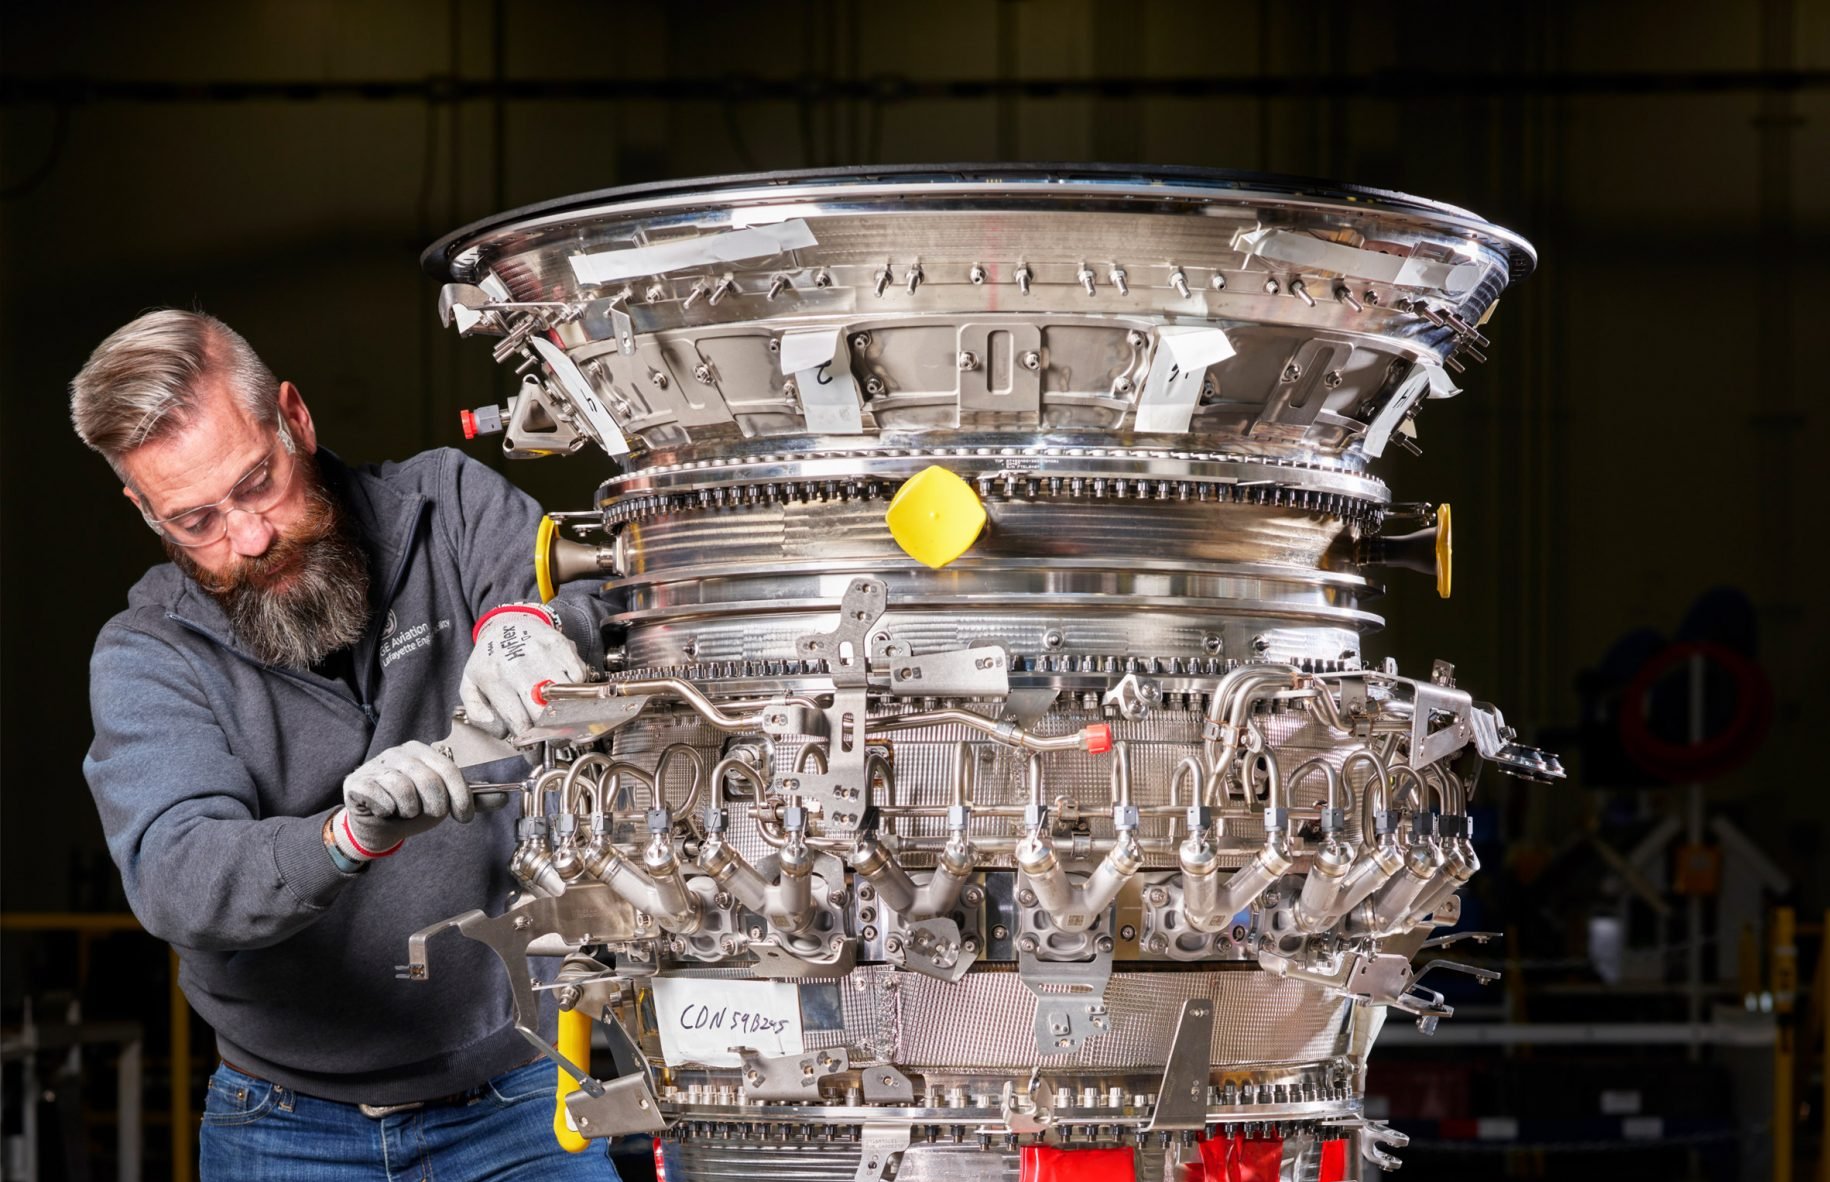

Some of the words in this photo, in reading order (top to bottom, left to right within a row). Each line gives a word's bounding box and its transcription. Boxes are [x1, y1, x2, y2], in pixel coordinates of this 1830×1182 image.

[391, 623, 429, 648] Aviation
[500, 625, 526, 662] HyFlex
[382, 642, 416, 667] Lafayette
